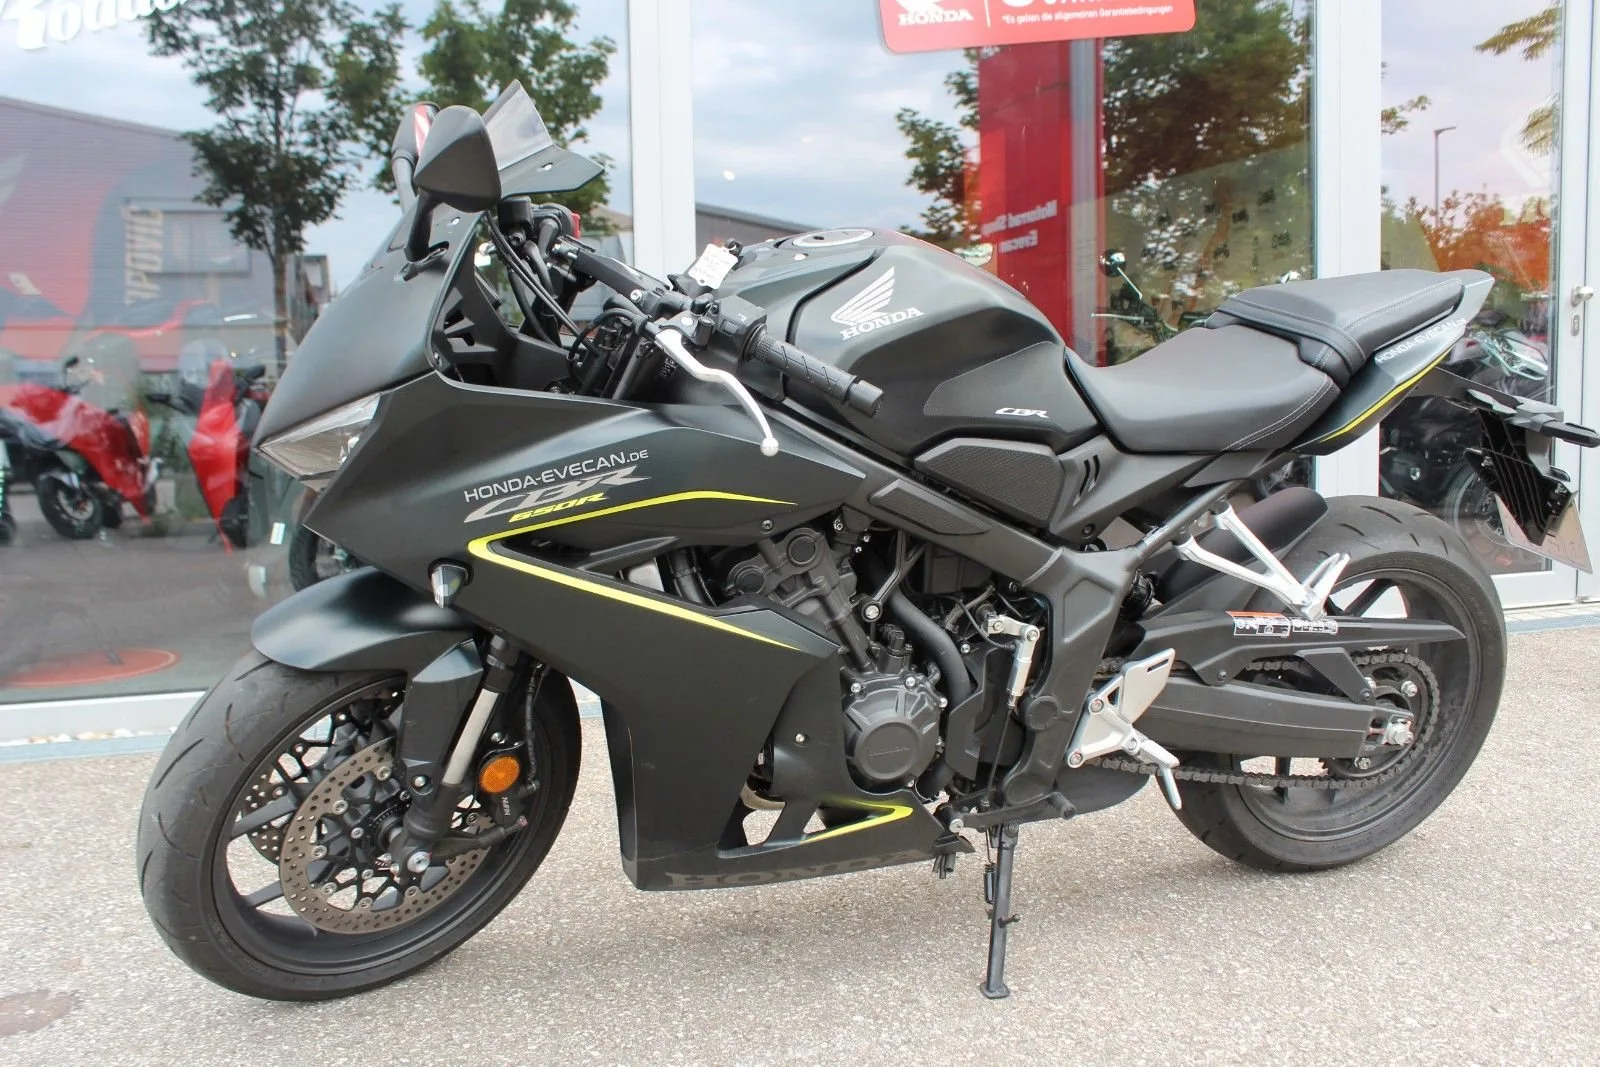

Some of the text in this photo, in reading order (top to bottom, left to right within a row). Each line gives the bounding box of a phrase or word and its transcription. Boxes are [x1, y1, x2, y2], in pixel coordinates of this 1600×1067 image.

[898, 9, 974, 26] HONDA
[1017, 14, 1040, 25] gelten
[1042, 12, 1053, 22] die
[1054, 10, 1098, 22] allgemeinen
[1099, 6, 1173, 18] Garantiebedingungen
[840, 307, 925, 341] HONDA
[995, 407, 1050, 418] CBR
[464, 450, 649, 502] HONDA-EVECAN.DE
[464, 465, 653, 524] CBR
[508, 493, 609, 523] 650R
[665, 850, 930, 888] HONDA
